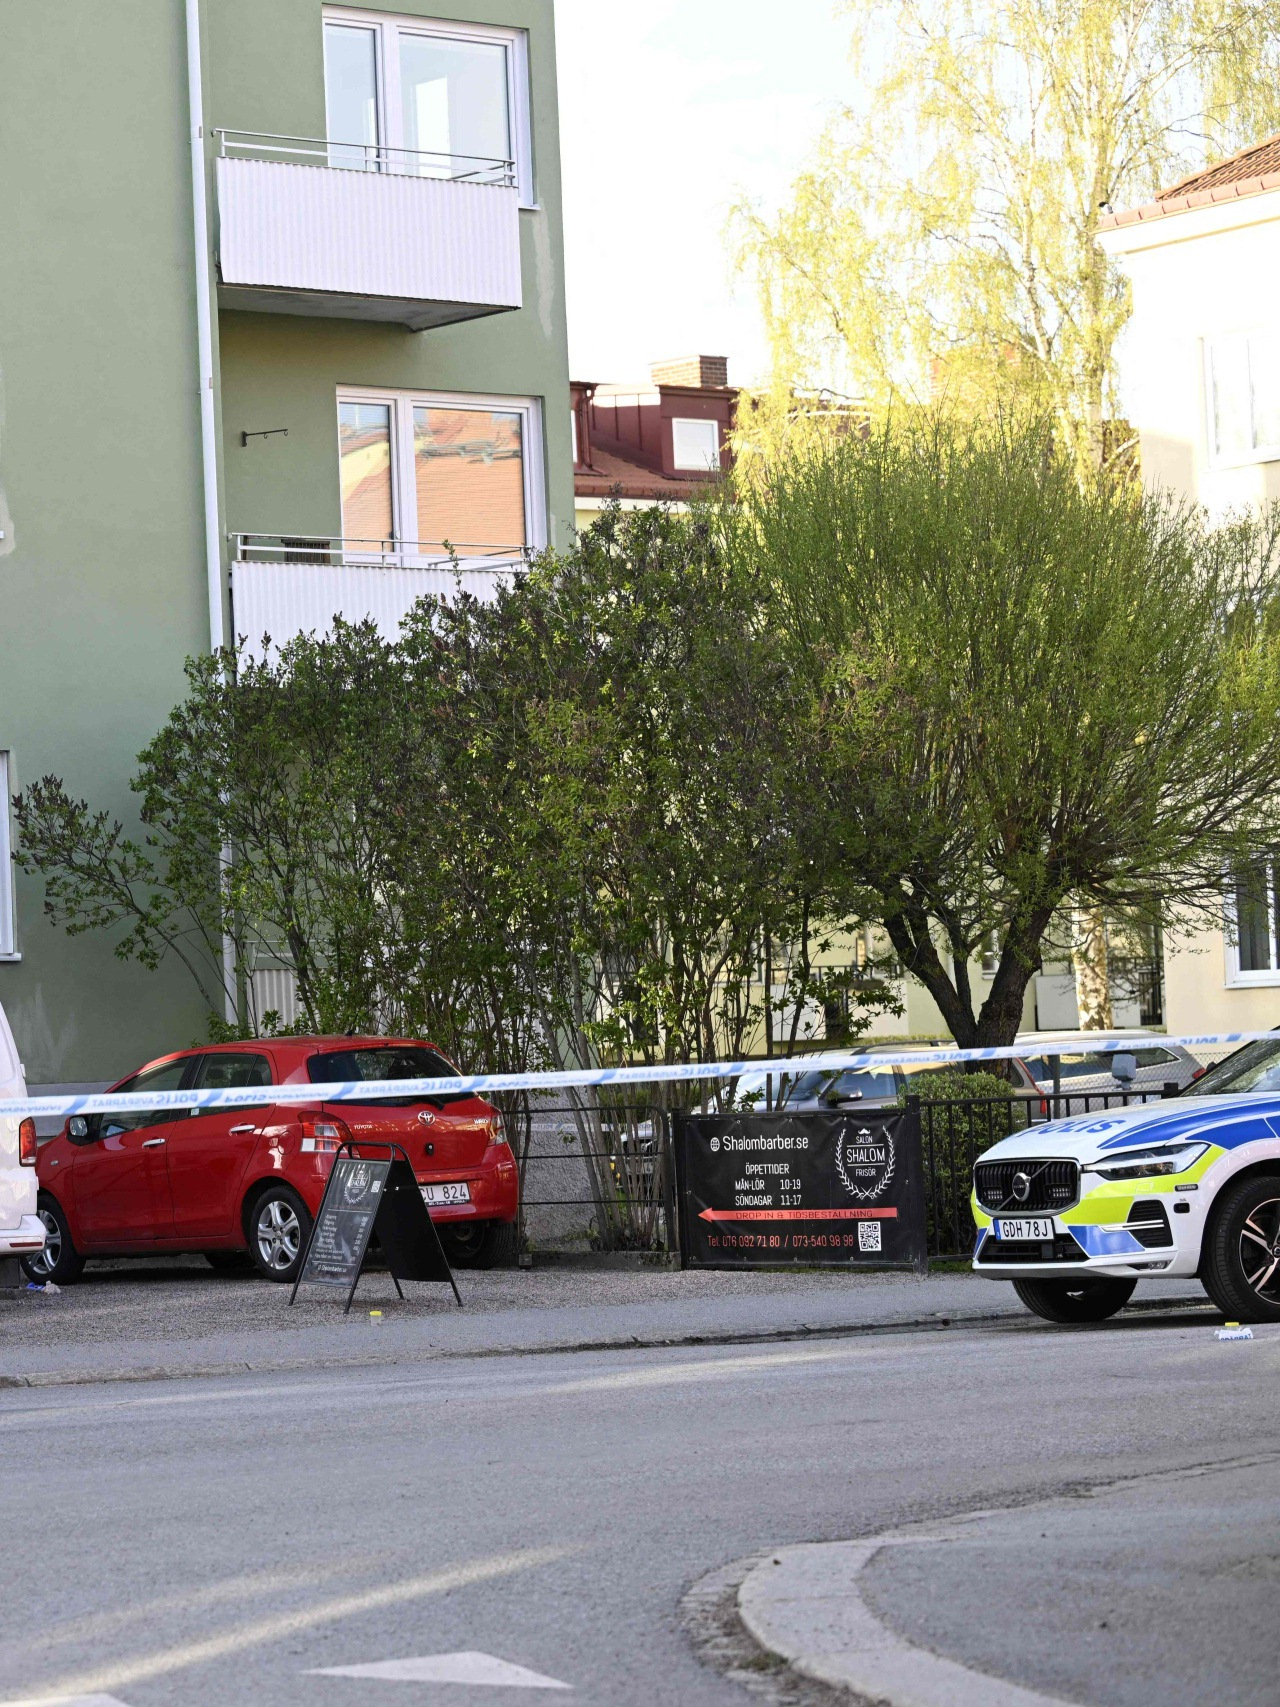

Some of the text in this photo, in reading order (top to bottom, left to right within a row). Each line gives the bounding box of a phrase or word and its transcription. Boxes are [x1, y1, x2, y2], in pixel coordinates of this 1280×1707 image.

[722, 1134, 809, 1151] Shalombarber.se
[855, 1136, 873, 1144] SALON
[846, 1148, 885, 1163] SHALOM
[745, 1162, 790, 1175] ÖPPETTIDER
[855, 1167, 877, 1177] FRISÖR
[735, 1178, 801, 1190] MÅN-LÖR 10-19
[442, 1185, 467, 1200] 824
[735, 1193, 802, 1206] SÖNDAGAR 11-17
[735, 1211, 762, 1220] DROP
[764, 1211, 774, 1219] IN
[1003, 1221, 1048, 1237] GDH 78J
[707, 1235, 854, 1247] Tel. 076 092 71 80 / 073-540 98 98
